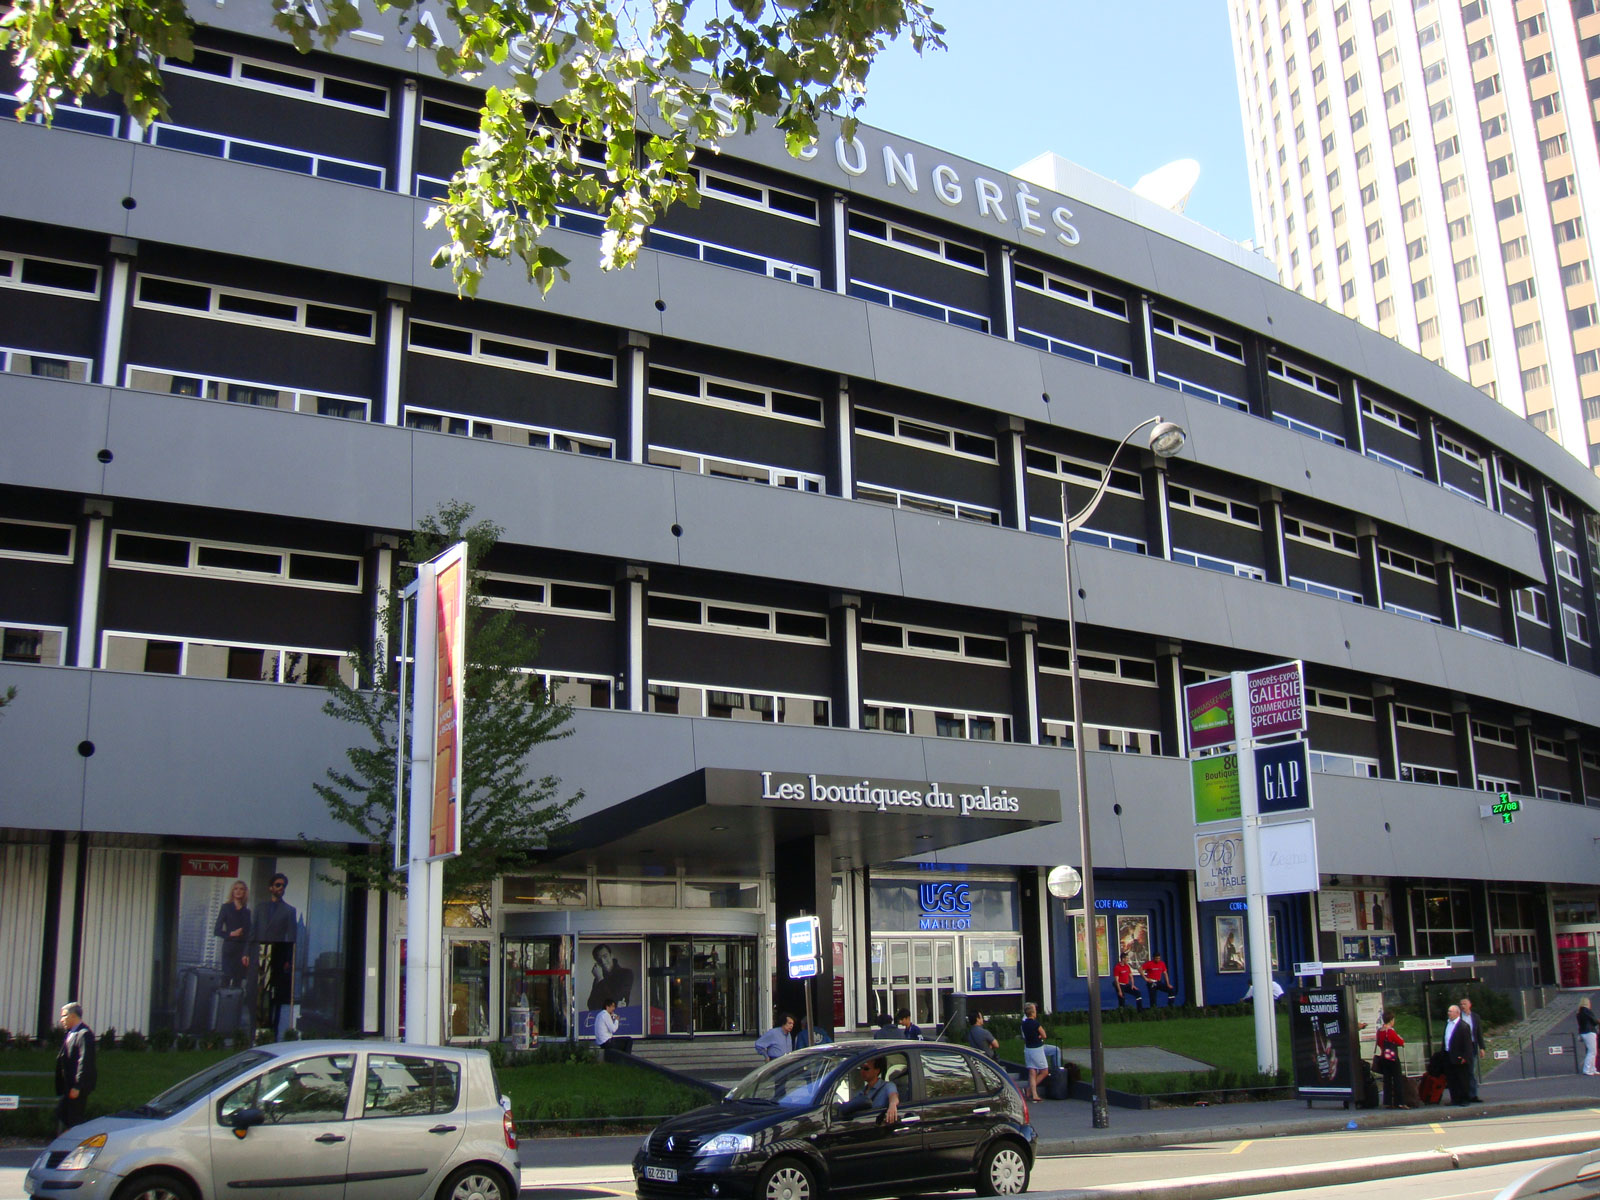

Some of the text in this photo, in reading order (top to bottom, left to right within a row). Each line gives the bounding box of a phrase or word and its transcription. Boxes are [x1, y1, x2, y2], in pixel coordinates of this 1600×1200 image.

[790, 125, 1081, 247] ONGRÈS
[1248, 670, 1300, 689] CONGRÈS-EXPOS
[1249, 681, 1301, 704] GALERIE
[1250, 697, 1302, 715] COMMERCIALE
[1251, 709, 1303, 728] SPECTACLES
[1263, 760, 1300, 801] GAP
[761, 772, 1019, 816] Les boutiques du palais
[1492, 802, 1517, 813] 27/08
[1211, 865, 1233, 878] L'ART
[1220, 876, 1247, 888] TABLE
[919, 883, 972, 913] UGC
[919, 918, 972, 931] MAILLOT
[1308, 993, 1338, 1004] VINAIGRE
[1299, 1004, 1339, 1015] BALSAMIQUE
